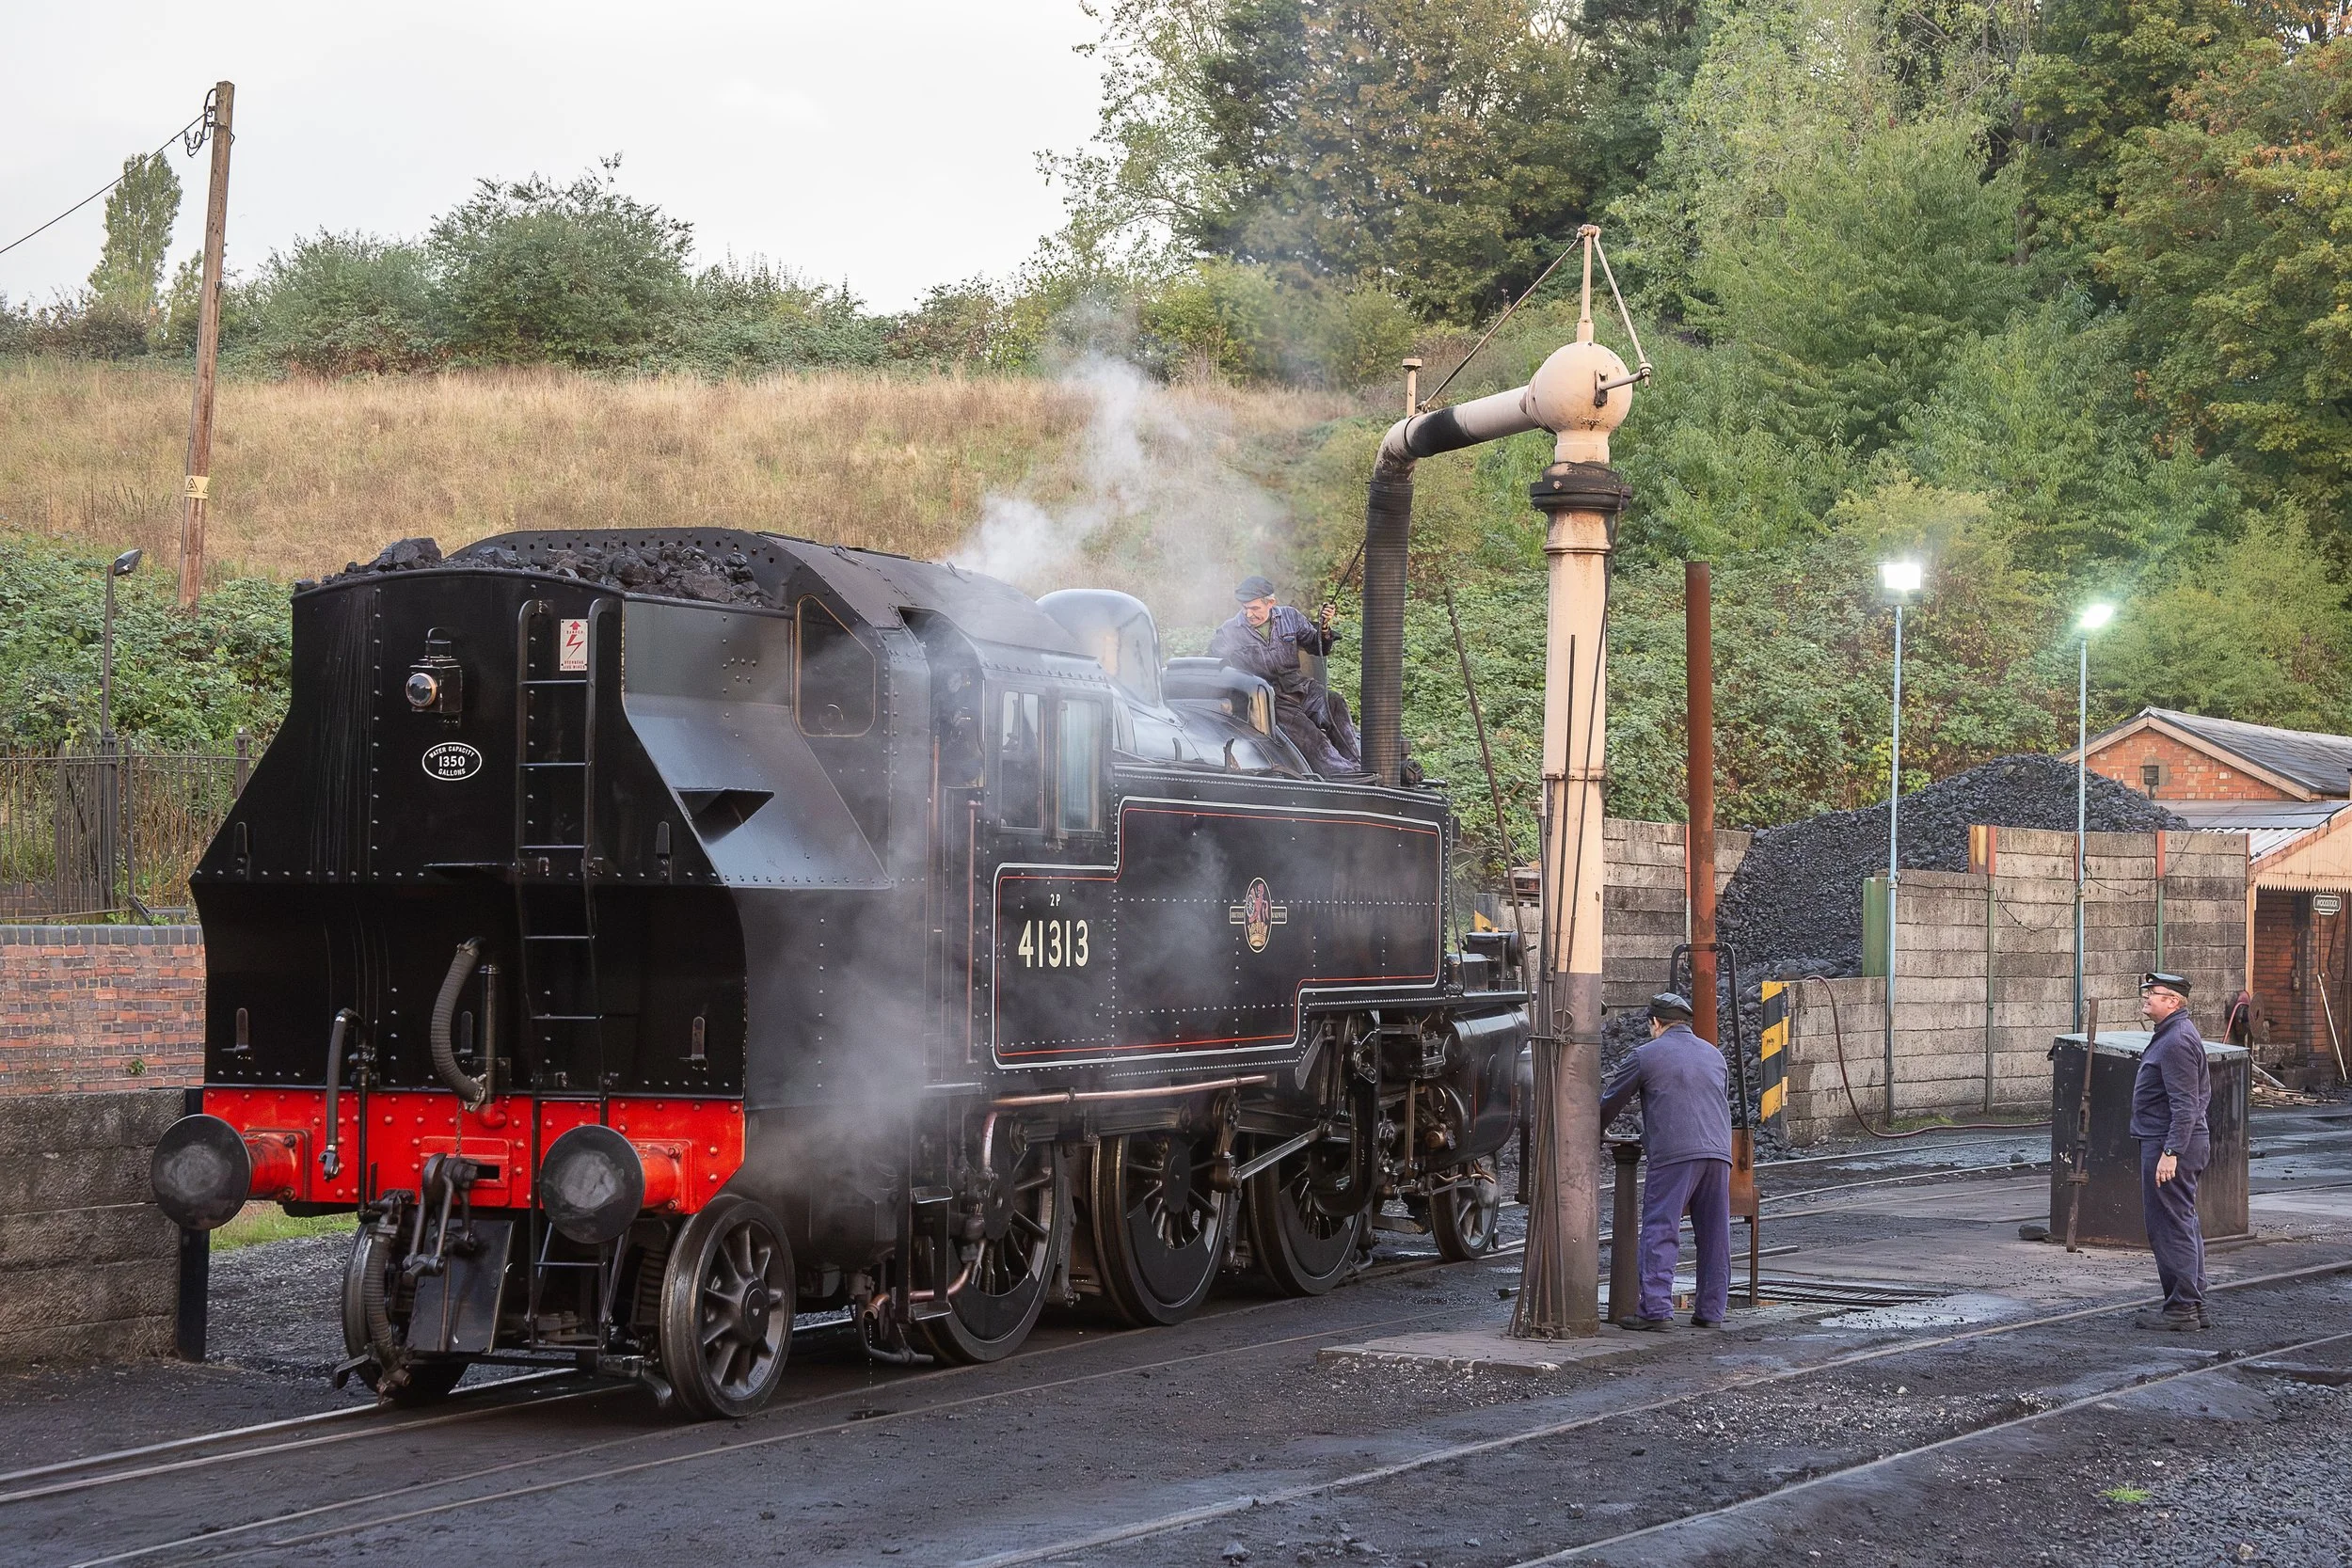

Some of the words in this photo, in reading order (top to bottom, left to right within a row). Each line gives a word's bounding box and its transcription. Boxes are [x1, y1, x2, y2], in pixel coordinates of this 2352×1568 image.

[429, 746, 447, 758] WATER
[448, 746, 475, 757] CAPACITY
[438, 755, 466, 768] 1350
[437, 768, 466, 776] GALLONS
[1050, 893, 1061, 907] 2P
[1018, 919, 1089, 968] 41313
